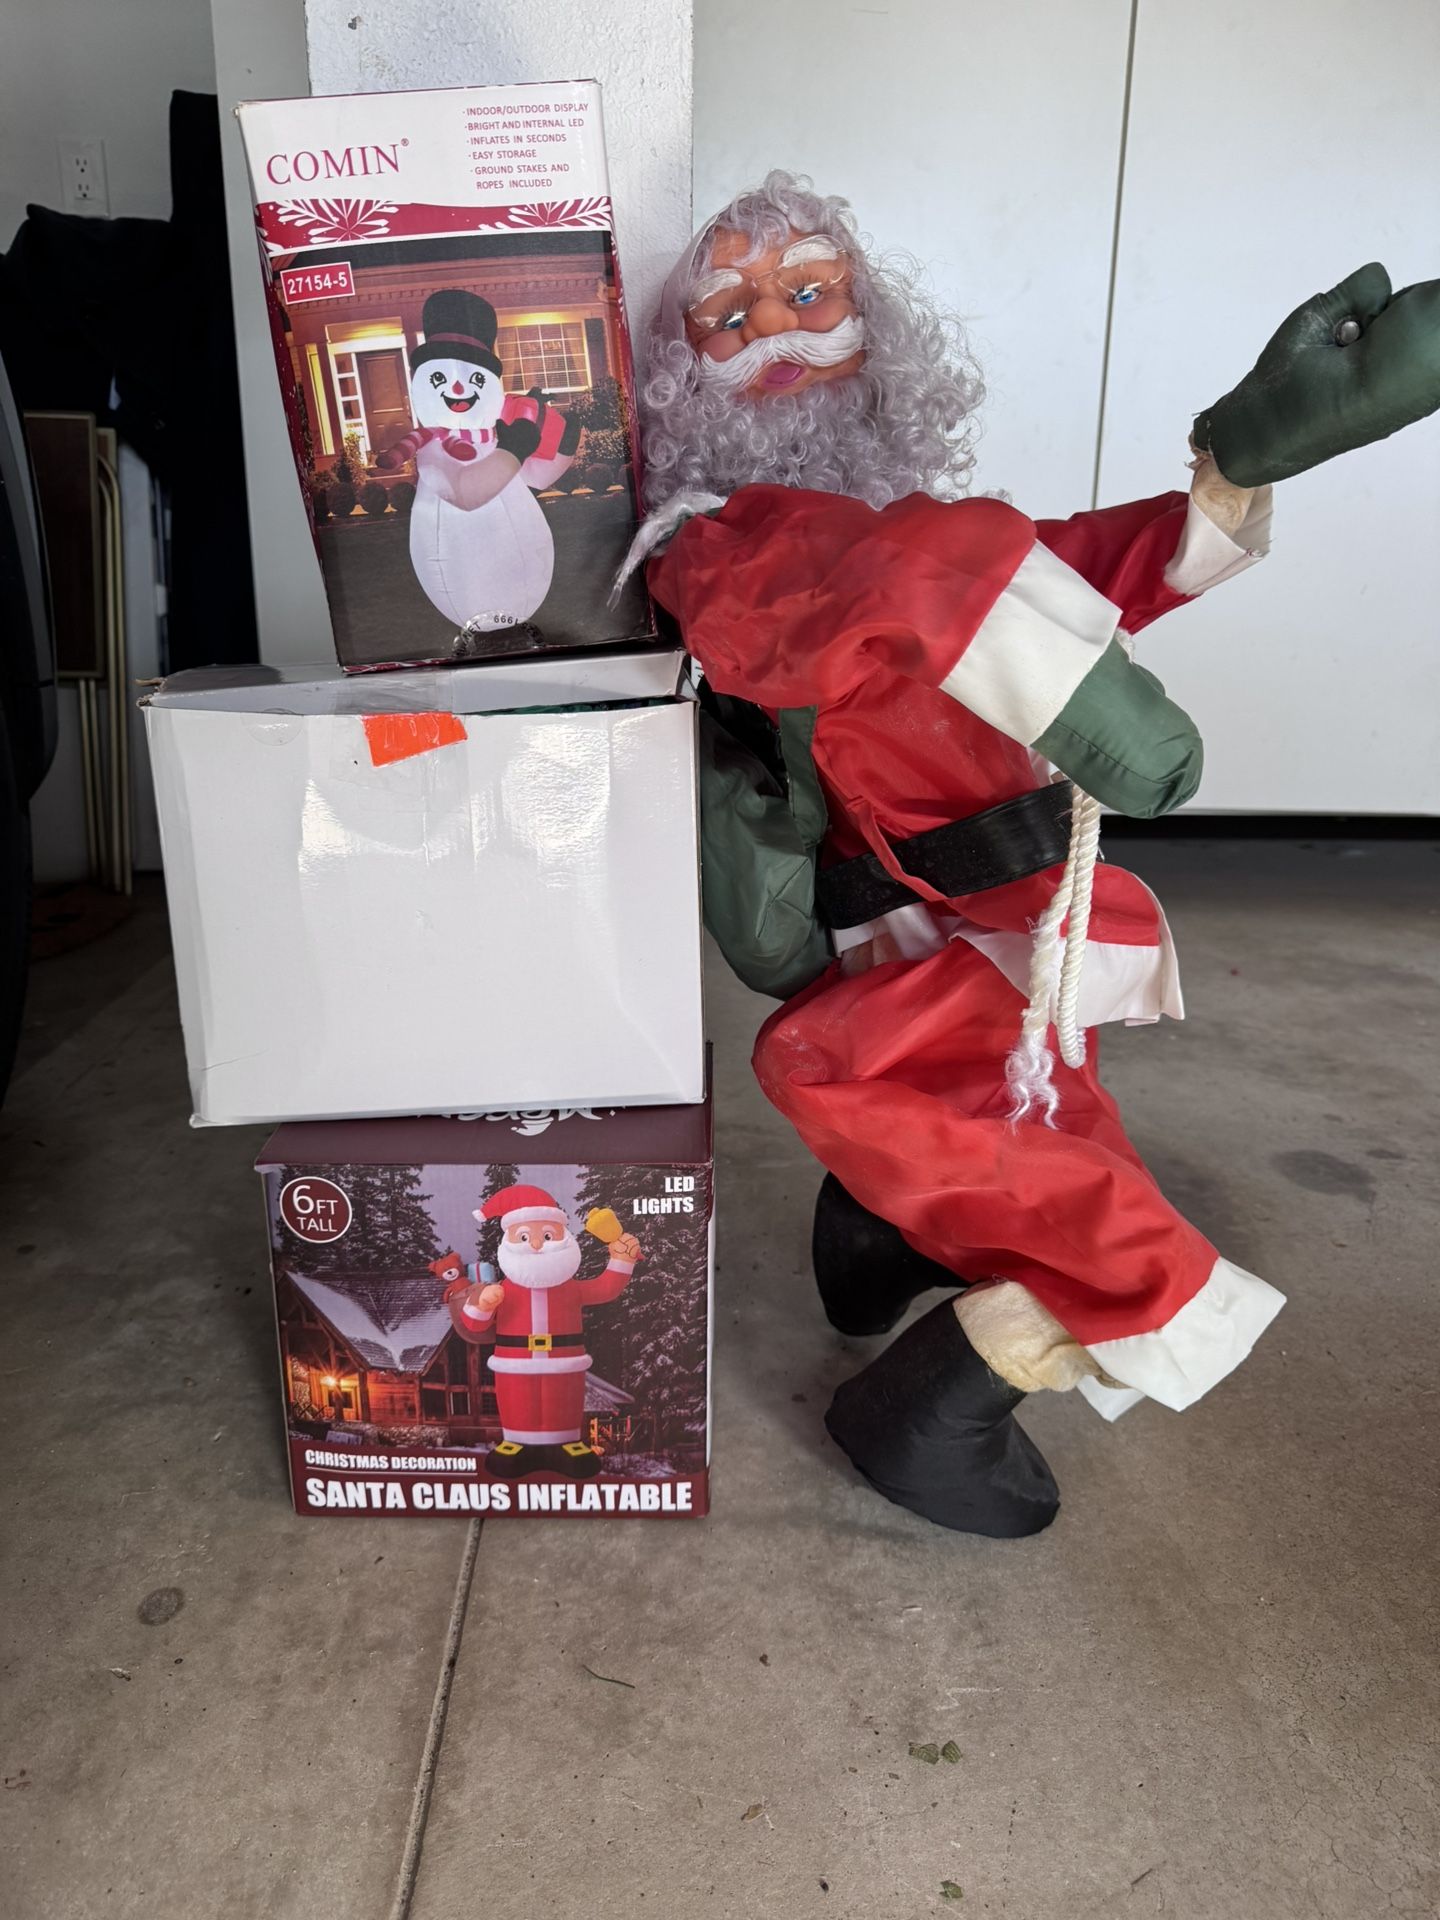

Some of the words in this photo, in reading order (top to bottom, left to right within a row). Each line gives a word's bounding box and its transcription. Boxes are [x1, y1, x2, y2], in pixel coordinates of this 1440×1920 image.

[466, 104, 551, 116] INDOOR/OUTDOOR
[553, 103, 589, 113] DISPLAY
[467, 121, 501, 131] BRIGHT
[501, 120, 521, 130] AND
[522, 119, 565, 129] INTERNAL
[568, 118, 585, 128] LED
[470, 135, 510, 145] INFLATES
[513, 135, 523, 144] IN
[526, 134, 567, 143] SECONDS
[472, 151, 494, 160] EASY
[496, 149, 537, 159] STORAGE
[474, 165, 514, 175] GROUND
[517, 164, 547, 173] STAKES
[550, 163, 570, 173] AND
[476, 180, 504, 190] ROPES
[508, 178, 553, 188] INCLUDED
[287, 271, 348, 295] 27154-5
[664, 1176, 695, 1194] LED
[632, 1196, 695, 1216] LIGHTS
[296, 1216, 338, 1233] TALL
[305, 1449, 389, 1470] CHRISTMAS
[390, 1455, 477, 1472] DECORATION
[305, 1477, 408, 1510] SANTA
[411, 1481, 511, 1511] CLAUS
[517, 1481, 693, 1512] INFLATABLE
